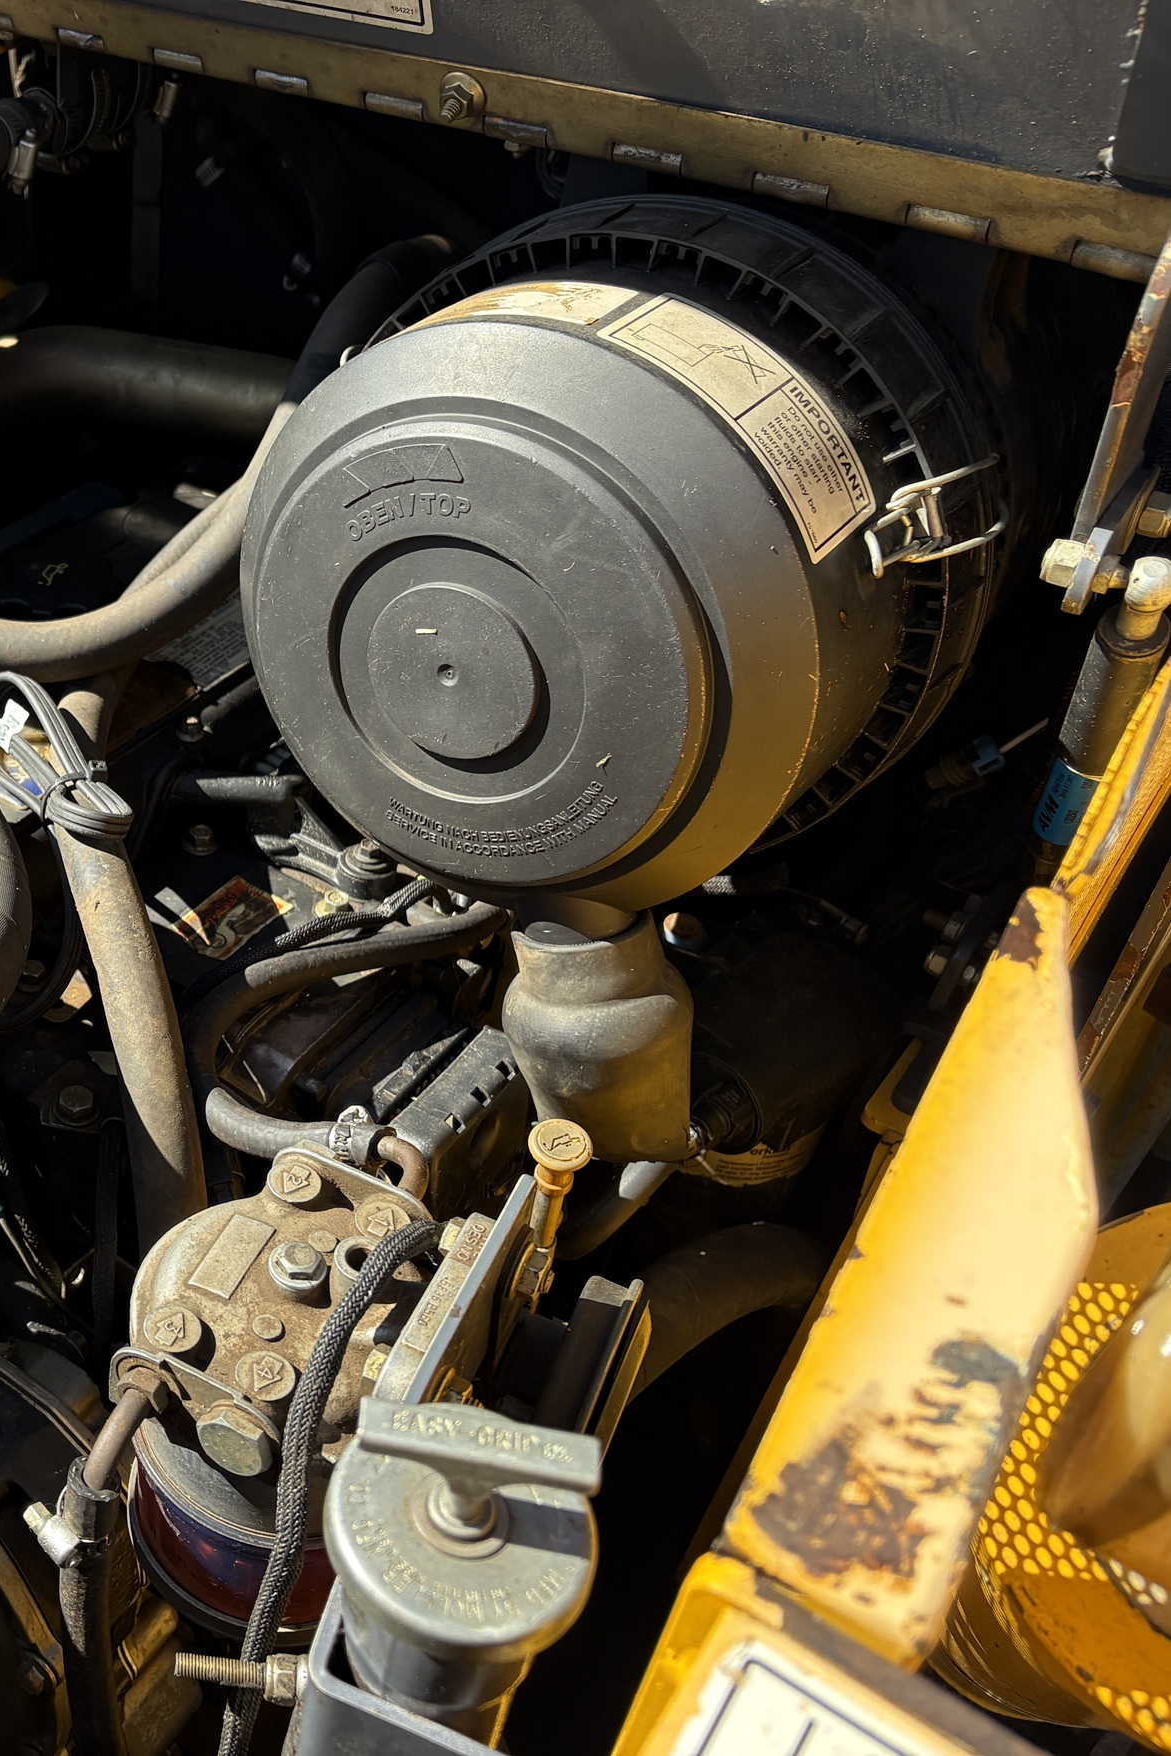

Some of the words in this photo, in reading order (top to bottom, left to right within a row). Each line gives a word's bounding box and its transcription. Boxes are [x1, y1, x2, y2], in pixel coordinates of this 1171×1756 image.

[754, 432, 781, 470] voided.
[761, 426, 796, 471] warranty
[793, 472, 809, 496] may
[807, 499, 817, 514] be
[767, 421, 783, 441] this
[783, 442, 808, 478] engine
[774, 416, 796, 444] fluids
[804, 457, 822, 484] start
[787, 407, 801, 422] Do
[801, 421, 815, 441] not
[814, 442, 828, 462] use
[827, 464, 843, 493] ether
[789, 386, 864, 502] IMPORTANT
[791, 422, 812, 450] other
[811, 451, 835, 495] starting
[385, 809, 437, 845] SERVICE
[455, 839, 545, 858] ACCORDANCE
[545, 826, 578, 850] WITH
[577, 793, 618, 835] MANUAL
[389, 796, 444, 833] WARTUNG
[446, 823, 480, 843] NACH
[480, 780, 605, 844] BEDIENUNGSANLEITUNG
[1038, 793, 1060, 832] AVM
[456, 1244, 473, 1261] NO
[465, 1223, 487, 1245] DES
